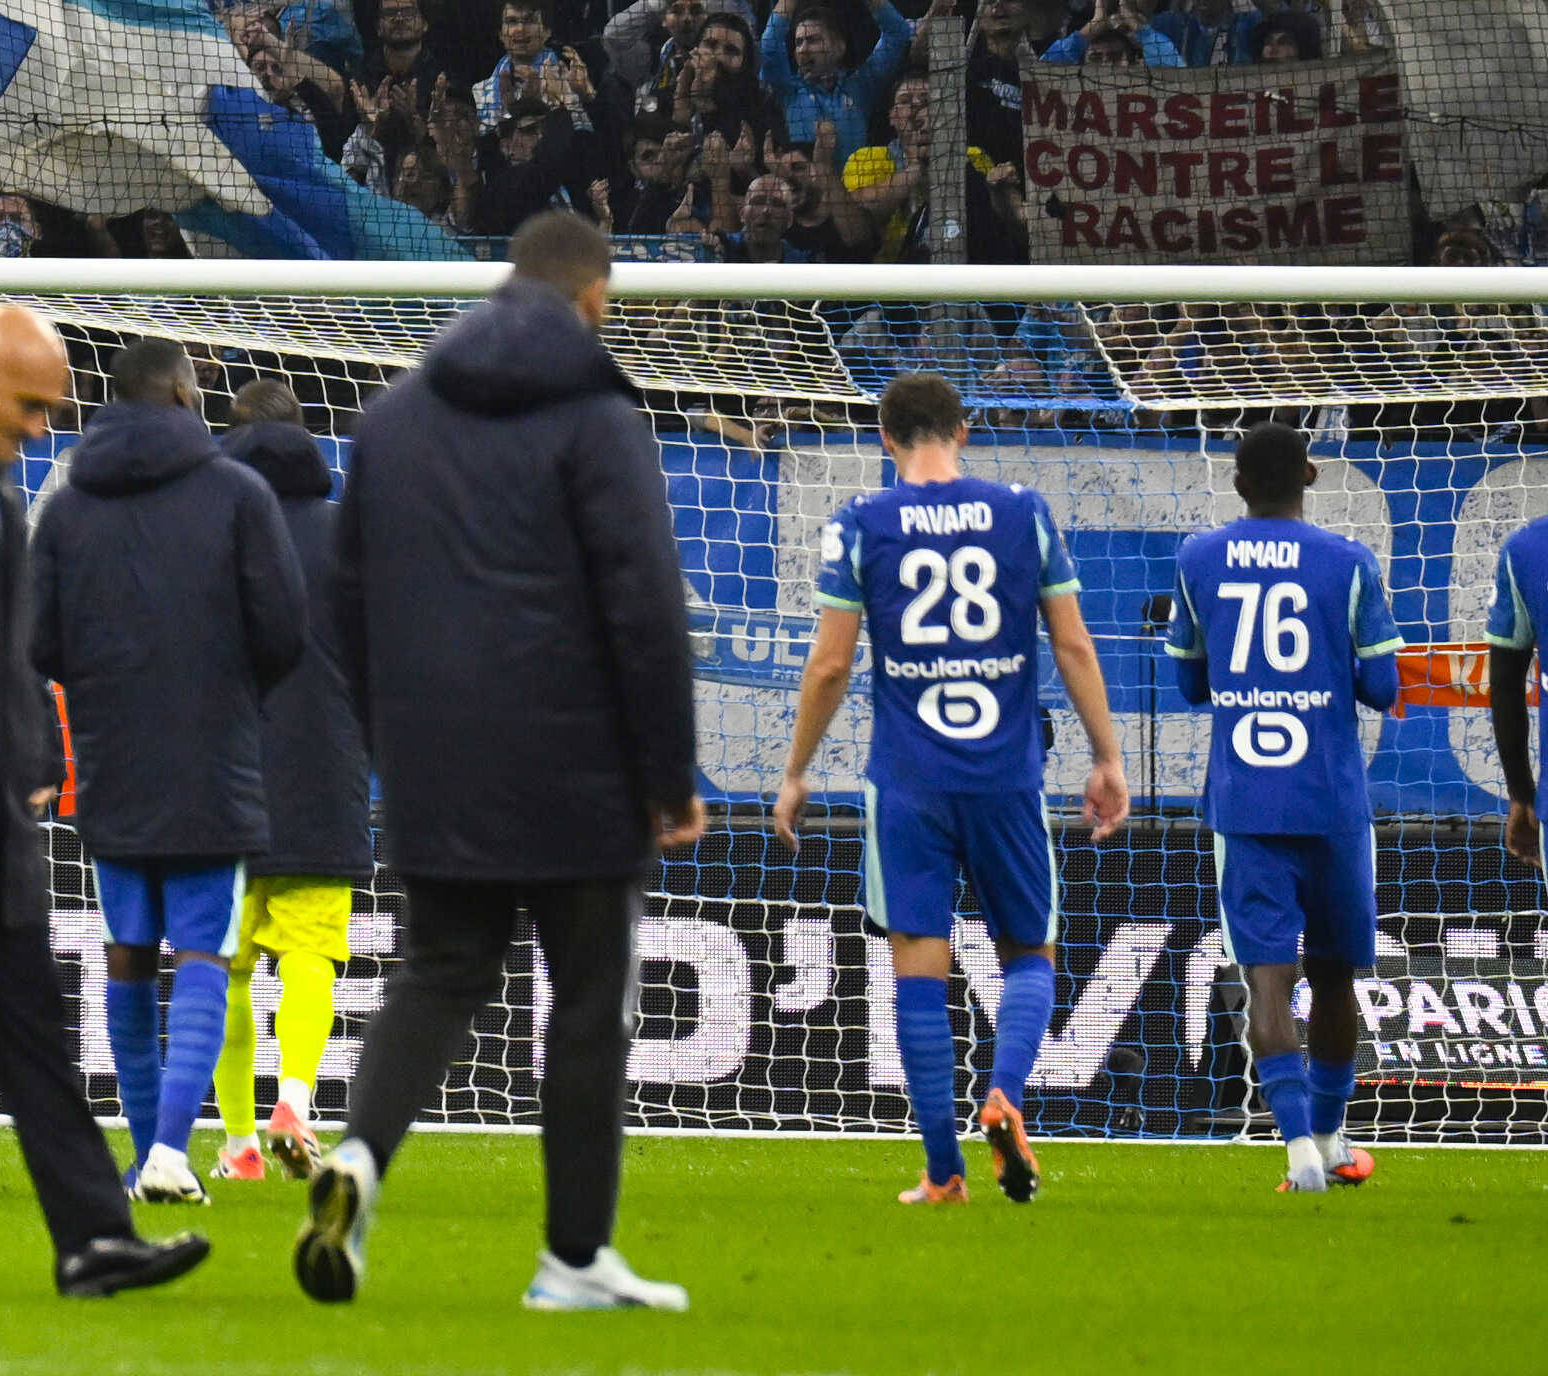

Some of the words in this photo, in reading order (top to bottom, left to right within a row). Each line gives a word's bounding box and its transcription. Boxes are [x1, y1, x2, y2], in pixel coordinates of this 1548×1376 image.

[1021, 71, 1404, 141] MARSEILLE
[1023, 140, 1296, 197] CONTRE
[1319, 132, 1405, 185] LE
[1059, 195, 1368, 254] RACISME
[898, 501, 994, 534] PAVARD
[1224, 540, 1301, 570] MMADI
[898, 546, 1002, 646] 28
[1217, 581, 1311, 675] 76
[883, 653, 1026, 684] boulanger
[1208, 686, 1333, 712] boulanger
[1355, 977, 1548, 1037] PARI
[1376, 1042, 1422, 1065] EN
[1440, 1042, 1548, 1067] LIGNE
